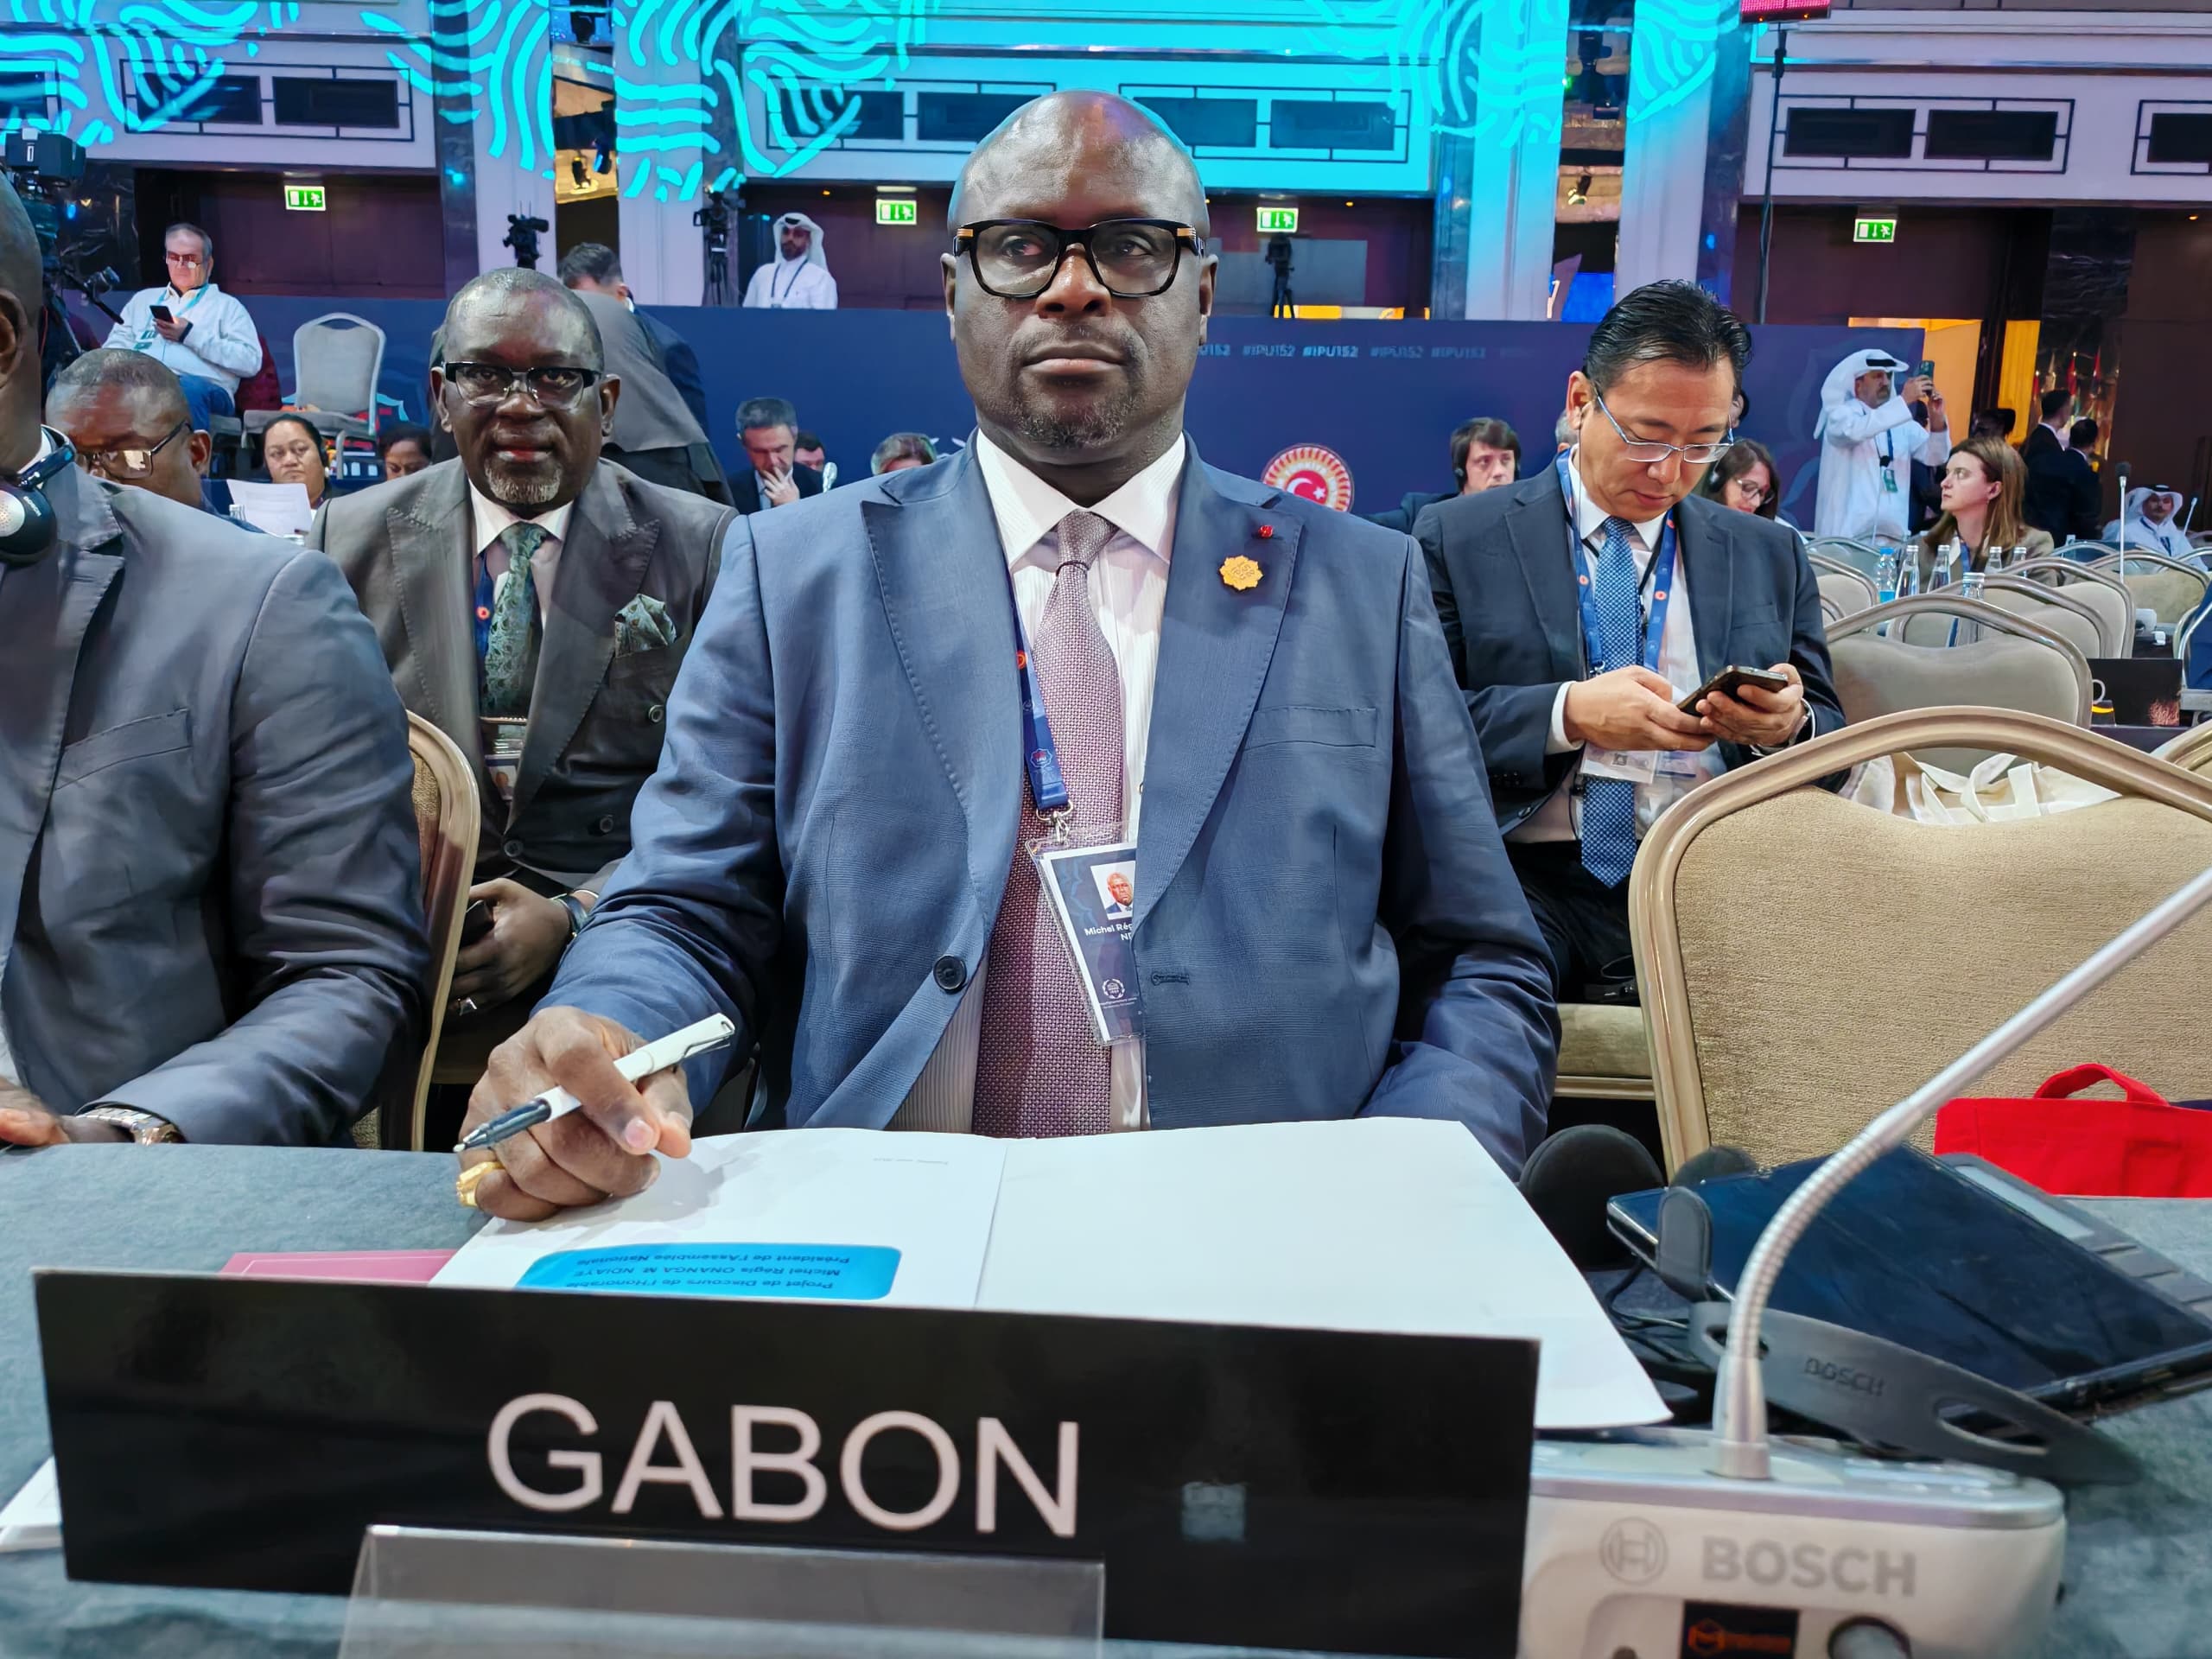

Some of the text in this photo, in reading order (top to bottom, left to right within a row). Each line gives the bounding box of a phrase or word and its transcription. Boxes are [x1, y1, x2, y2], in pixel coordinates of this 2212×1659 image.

[1302, 346, 1358, 357] #IPU152
[1084, 925, 1115, 936] Michel
[576, 1255, 650, 1265] Nationale
[776, 1255, 851, 1264] Président
[574, 1268, 635, 1277] NDIAYE
[741, 1266, 785, 1274] Régis
[788, 1268, 842, 1276] Michel
[566, 1280, 658, 1288] l'Honorable
[785, 1280, 834, 1289] Projet
[486, 1393, 1081, 1540] GABON
[1701, 1535, 1916, 1597] BOSCH
